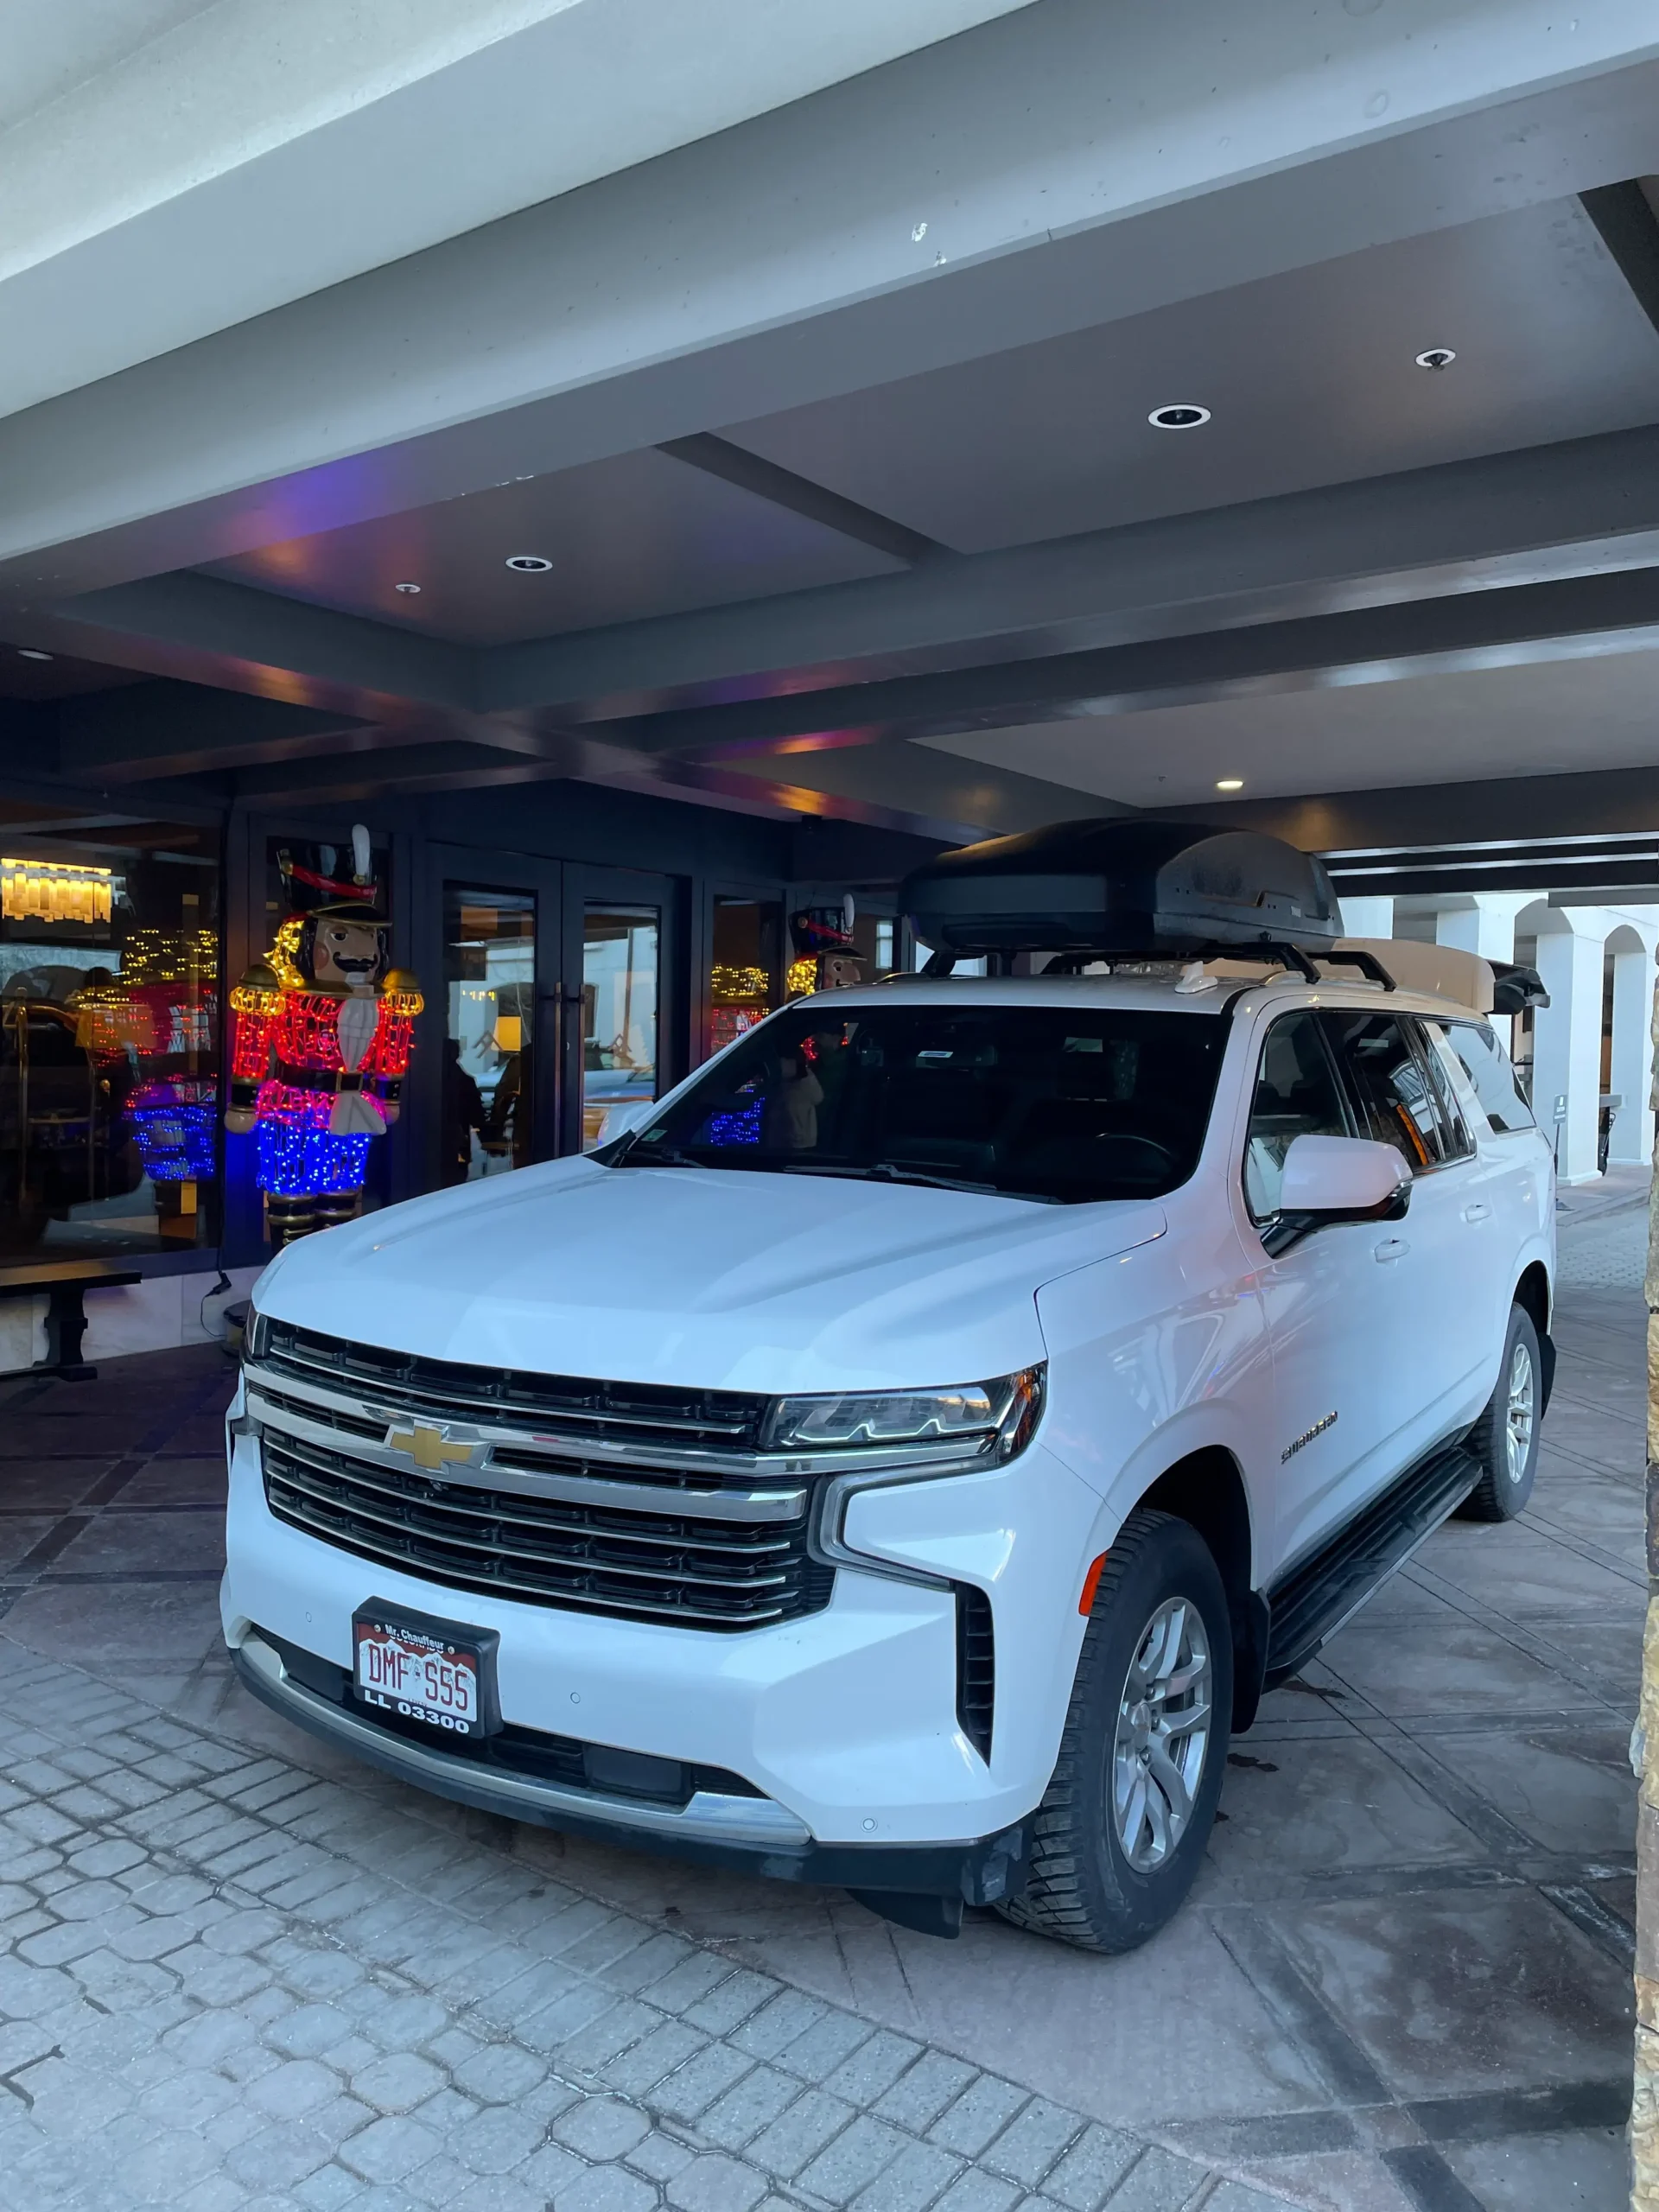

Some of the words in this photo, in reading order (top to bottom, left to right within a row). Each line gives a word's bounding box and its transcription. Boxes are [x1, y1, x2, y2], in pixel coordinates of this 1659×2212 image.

[385, 1624, 400, 1637] Mr.
[400, 1629, 445, 1650] Chauffeur
[364, 1689, 391, 1710] LL
[397, 1703, 470, 1735] 03300
